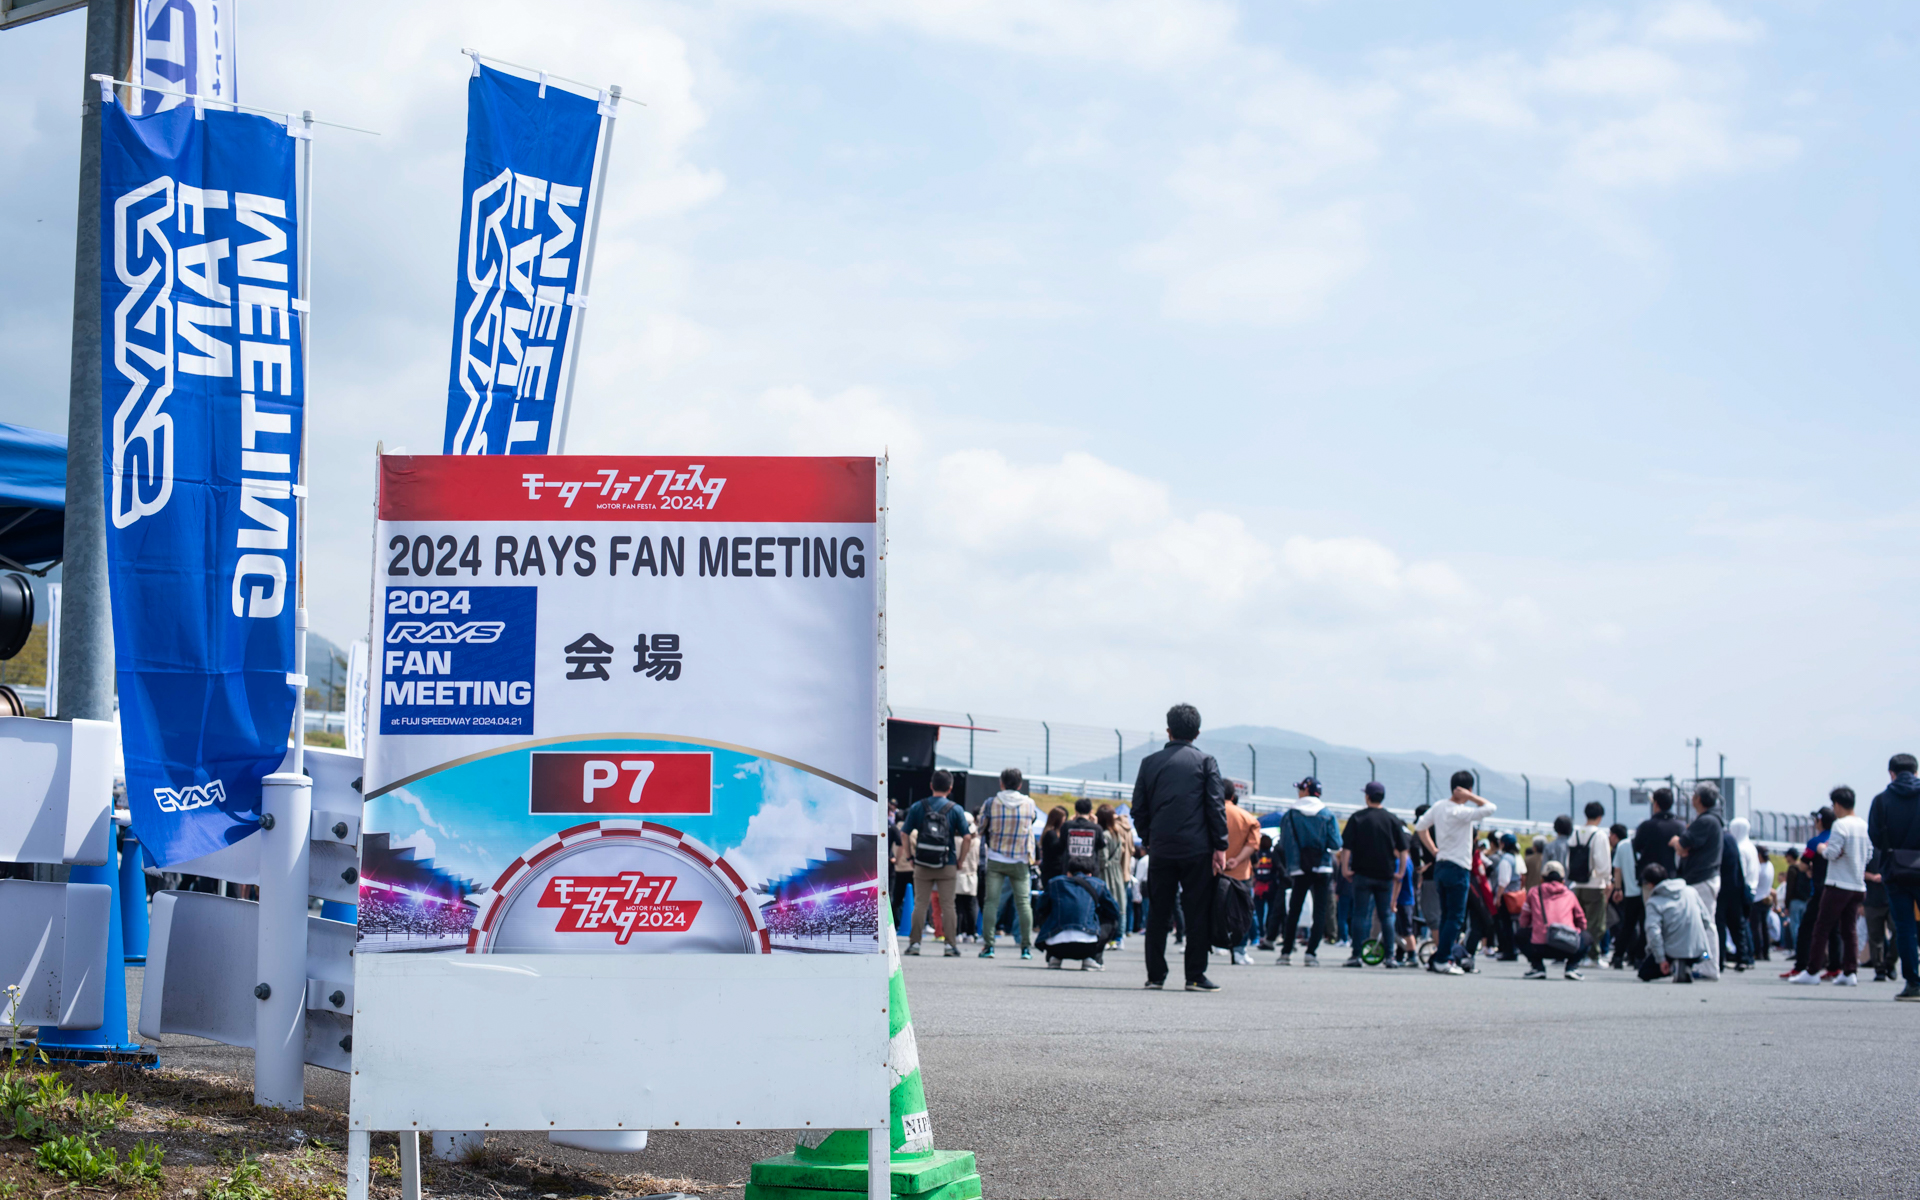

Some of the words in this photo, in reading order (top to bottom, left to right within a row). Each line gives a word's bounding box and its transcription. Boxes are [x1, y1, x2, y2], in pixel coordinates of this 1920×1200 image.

[522, 465, 727, 510] モーターファンフェスタ
[660, 496, 705, 510] 2024
[387, 535, 482, 577] 2024
[495, 535, 596, 577] RAYS
[609, 536, 685, 577] FAN
[700, 536, 866, 578] MEETING
[388, 590, 471, 614] 2024
[386, 621, 506, 644] RAYS
[385, 651, 452, 675] FAN
[564, 632, 683, 682] 会場
[384, 681, 532, 706] MEETING
[391, 717, 400, 725] at
[401, 717, 420, 725] FUJI
[421, 717, 471, 725] SPEEDWAY
[472, 717, 522, 725] 2024.04.21
[583, 760, 655, 804] P7
[638, 912, 686, 927] 2024
